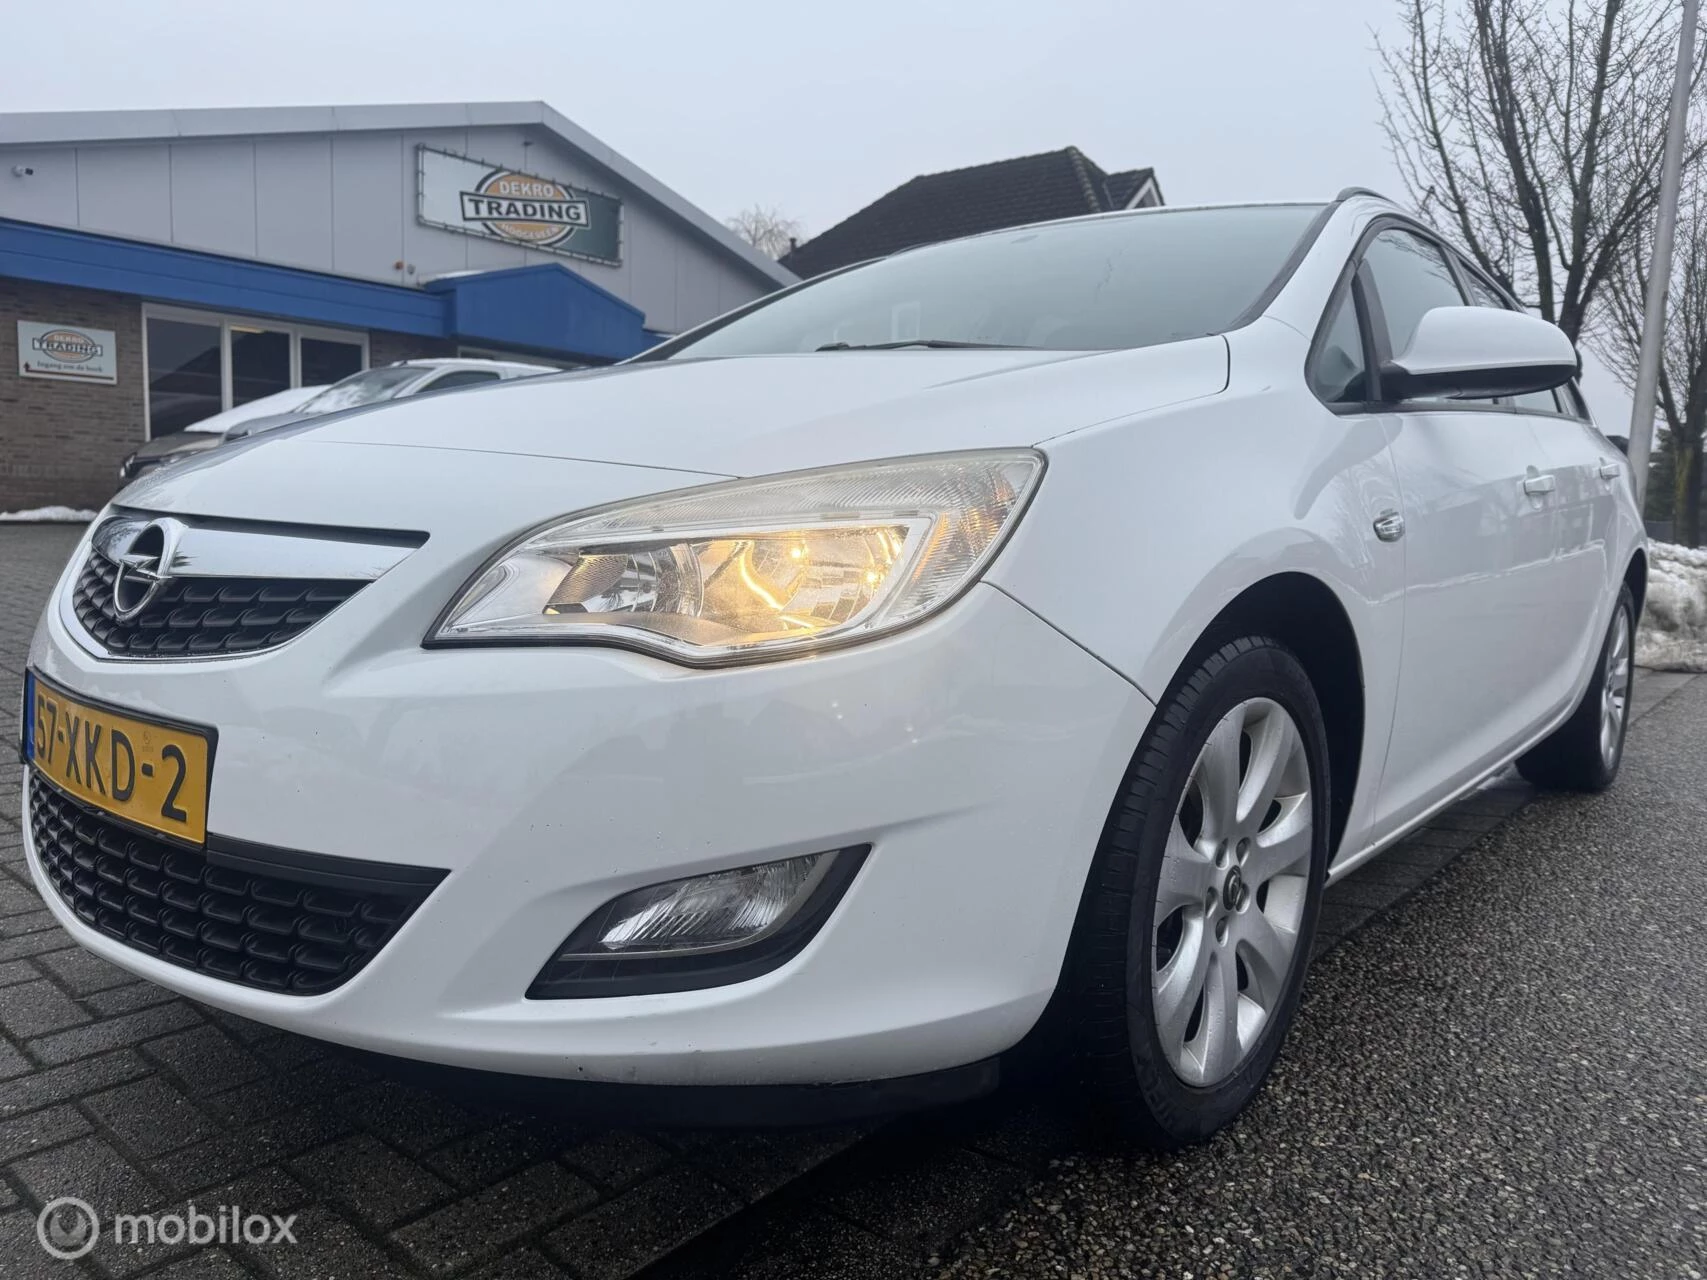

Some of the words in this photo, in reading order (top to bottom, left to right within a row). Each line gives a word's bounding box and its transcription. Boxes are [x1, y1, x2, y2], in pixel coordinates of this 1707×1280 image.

[499, 181, 555, 198] DEKRO
[468, 198, 581, 221] TRADING
[37, 339, 98, 355] TRADING
[37, 692, 187, 824] 57-XKD-2
